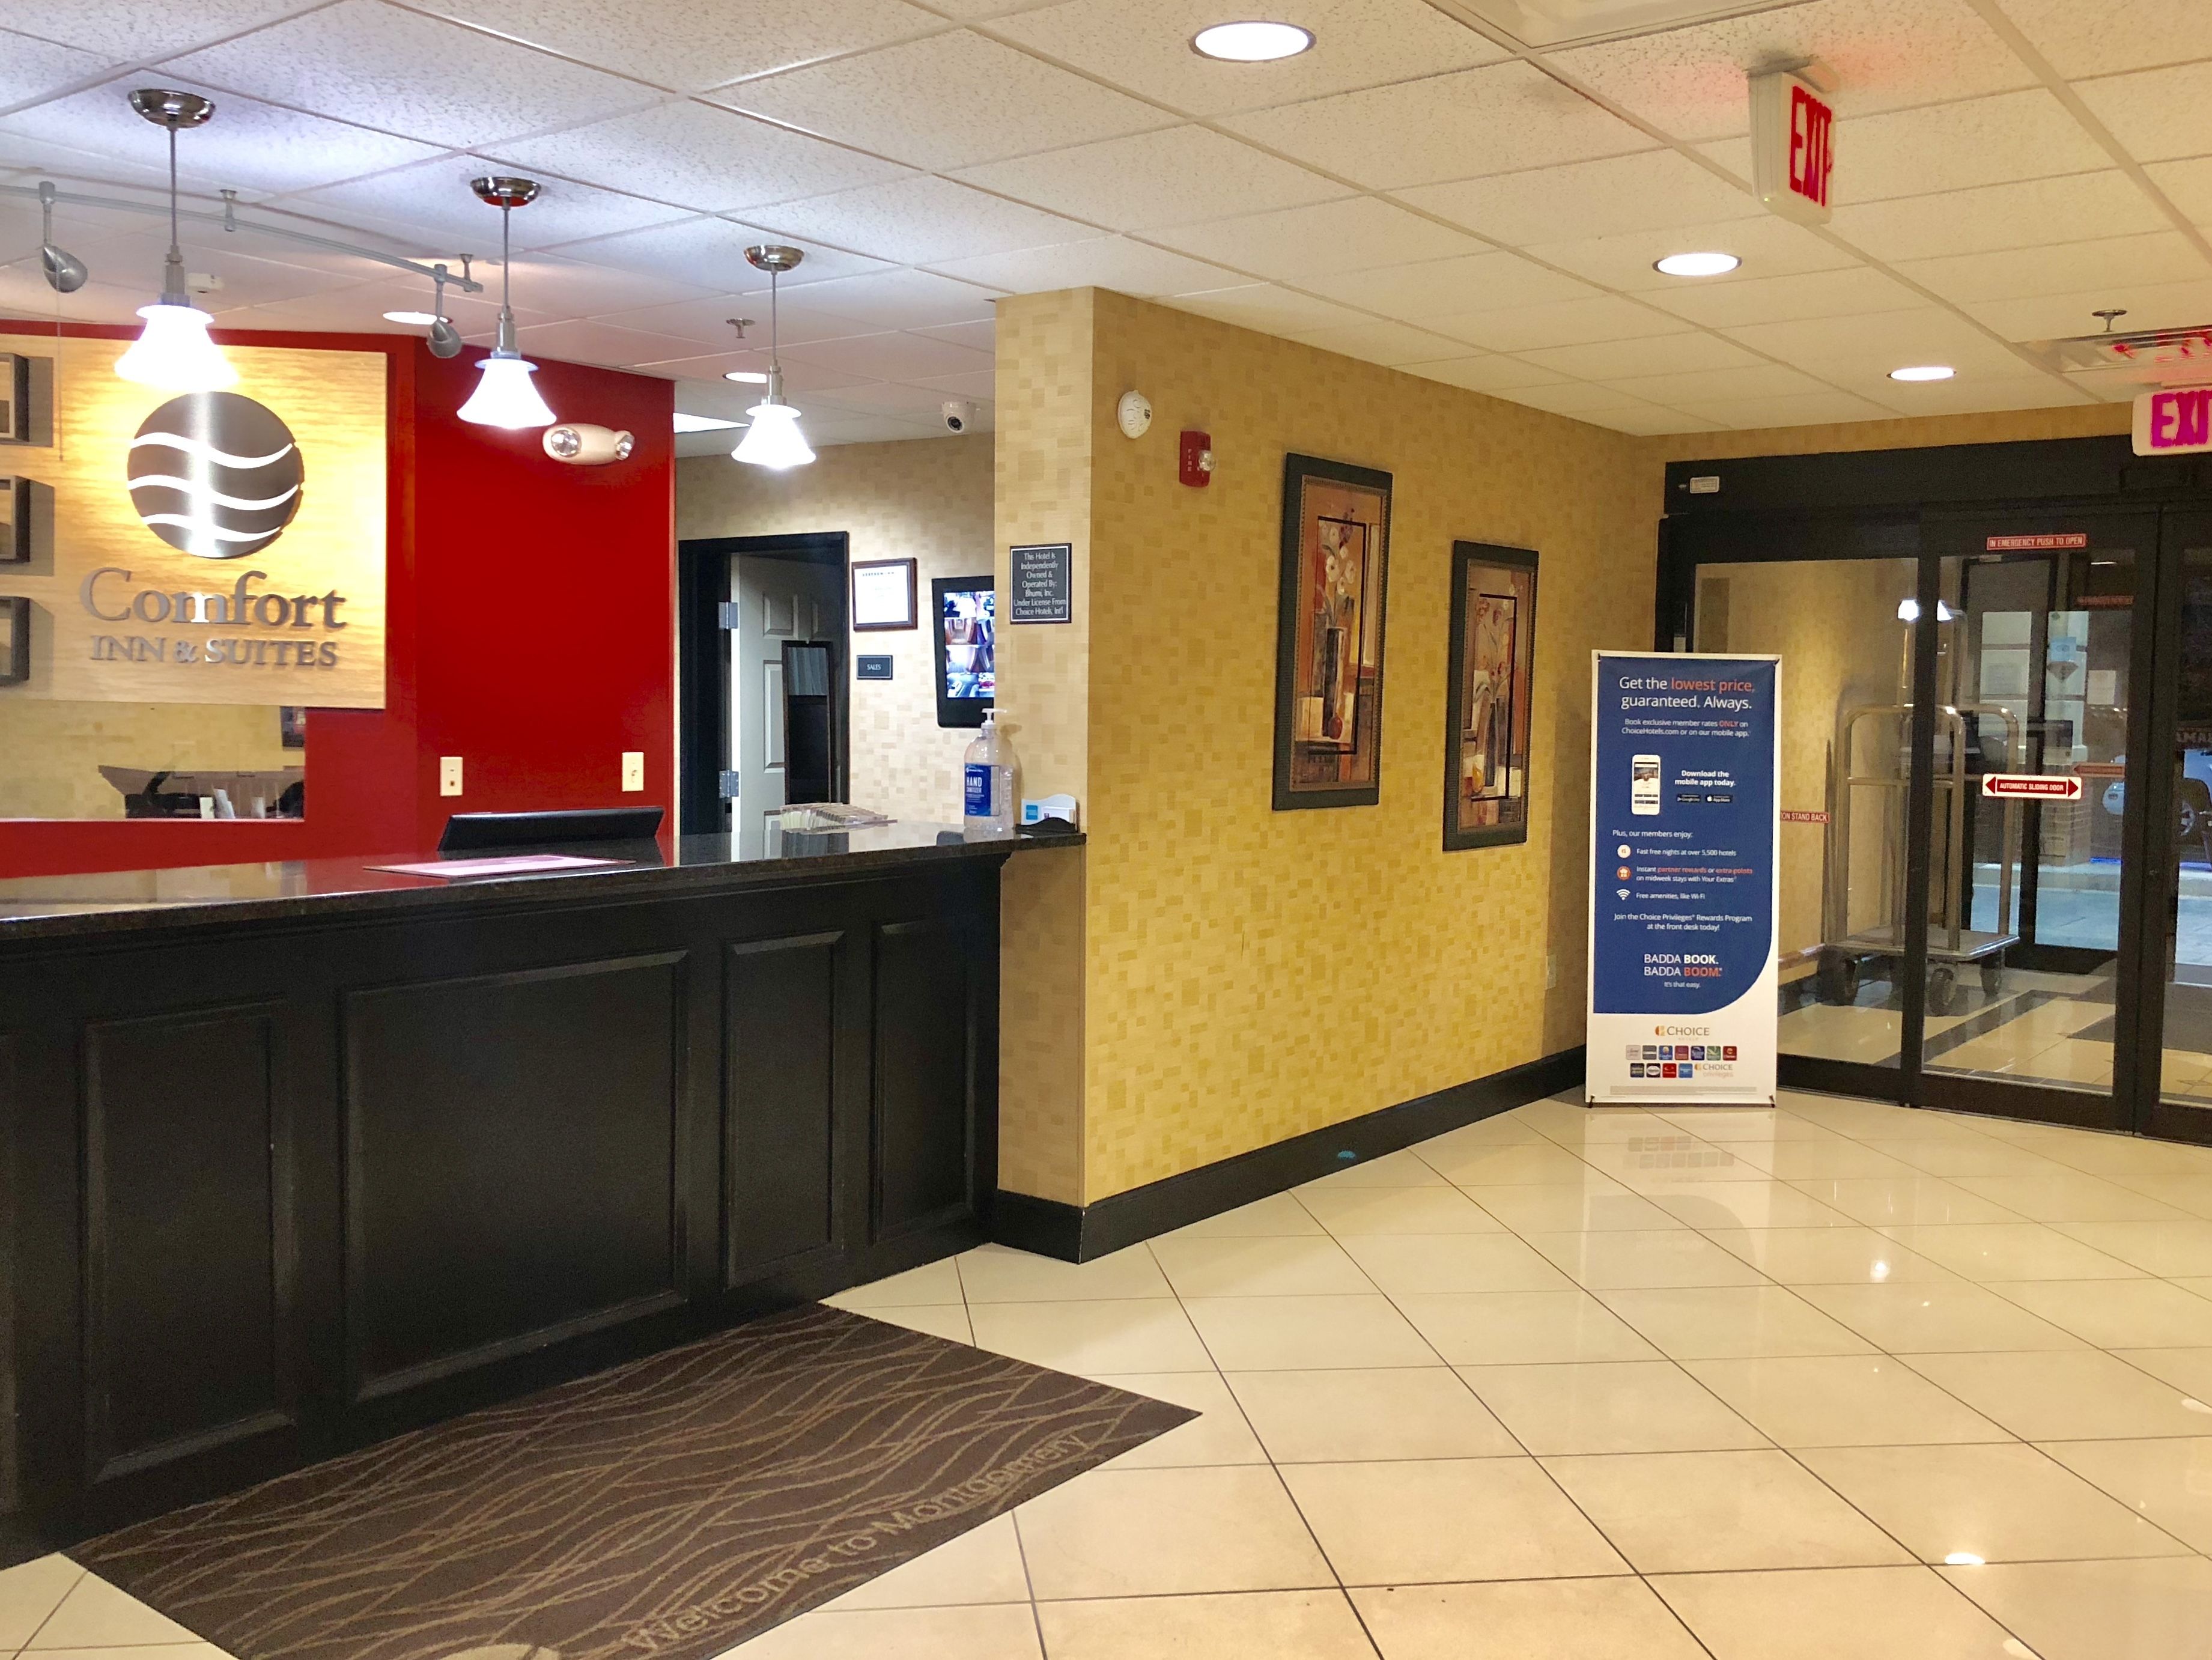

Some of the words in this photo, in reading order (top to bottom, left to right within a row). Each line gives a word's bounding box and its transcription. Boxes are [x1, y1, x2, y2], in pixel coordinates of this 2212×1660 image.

[1790, 85, 1832, 207] EXIT
[2151, 390, 2212, 448] EXI
[1998, 538, 2035, 547] EMERGENCY
[2037, 538, 2053, 546] PUSH
[2065, 537, 2082, 545] OPEN
[1021, 561, 1059, 571] Independently
[1026, 571, 1047, 579] Owned
[1022, 580, 1047, 588] Operated
[79, 567, 347, 629] Comfort
[1015, 607, 1034, 616] Choice
[90, 634, 166, 661] INN
[174, 640, 199, 663] &
[204, 638, 339, 667] SUITES
[1619, 676, 1642, 690] Get
[1646, 677, 1668, 690] the
[1671, 678, 1716, 691] lowest
[1621, 695, 1701, 710] guaranteed.
[1704, 696, 1752, 713] Always.
[1682, 770, 1716, 778] Download
[966, 776, 982, 787] HAND
[1714, 779, 1737, 788] today.
[1811, 813, 1828, 822] BACK
[1724, 914, 1752, 923] Program
[1644, 953, 1682, 964] BADDA
[1683, 954, 1719, 964] BOOK.
[1644, 966, 1682, 976] BADDA
[1667, 1026, 1710, 1036] CHOICE
[622, 1557, 835, 1652] Welcome
[829, 1533, 877, 1558] to
[871, 1432, 1089, 1537] Montgomery
